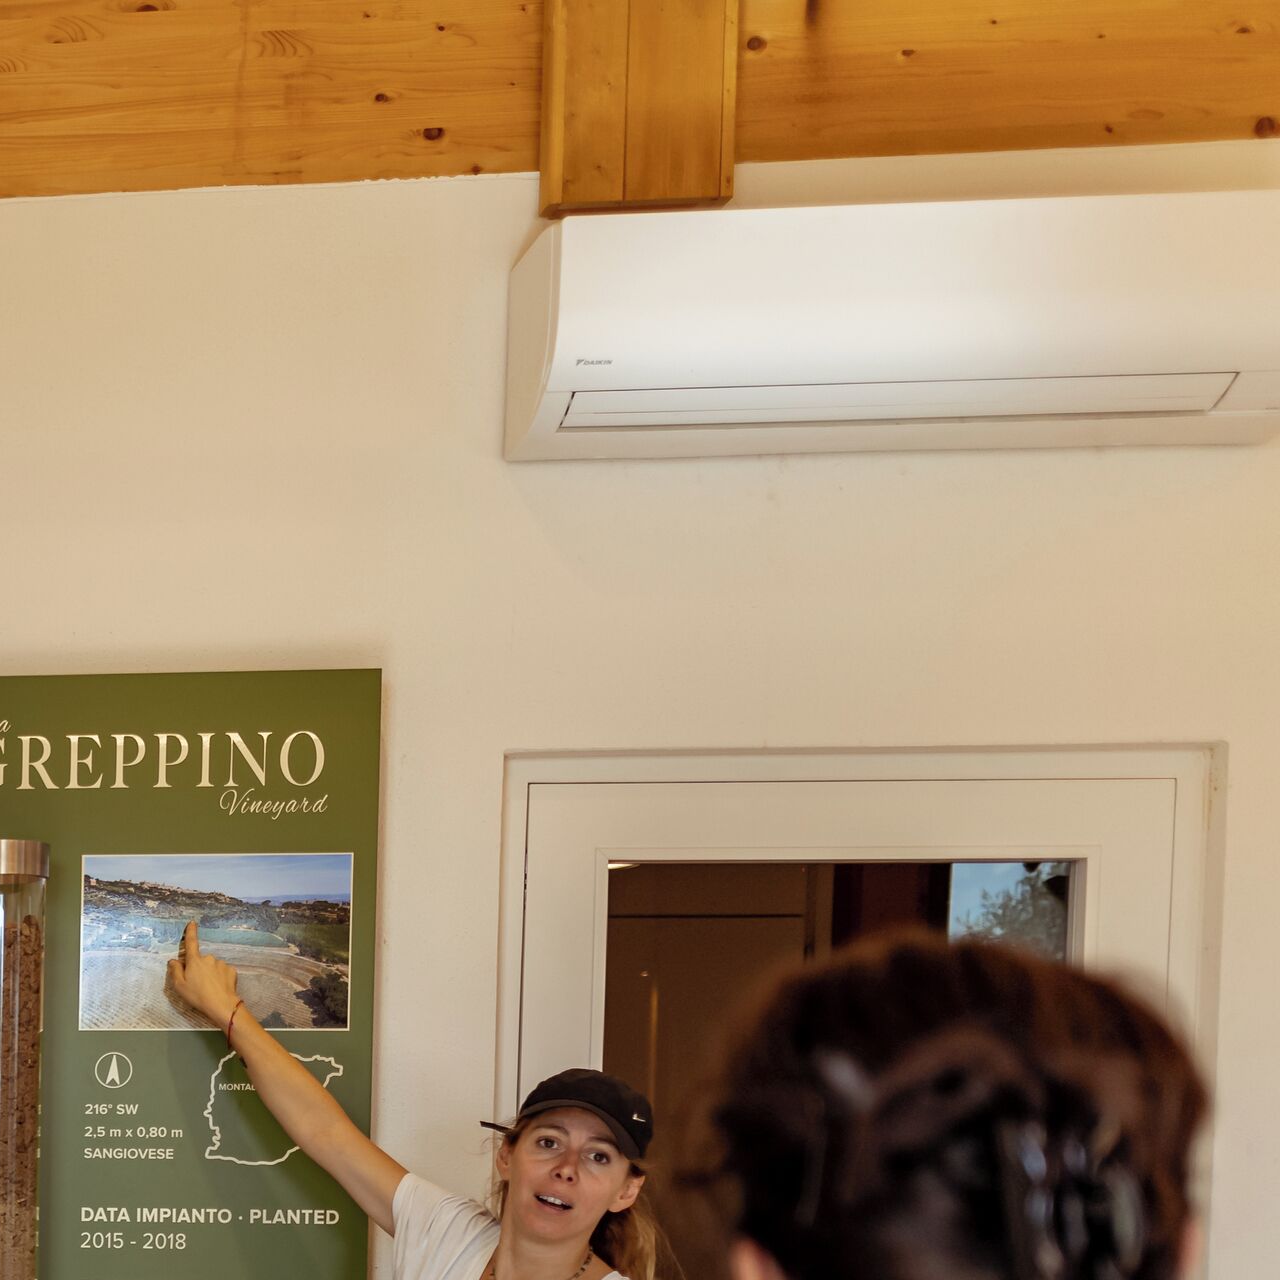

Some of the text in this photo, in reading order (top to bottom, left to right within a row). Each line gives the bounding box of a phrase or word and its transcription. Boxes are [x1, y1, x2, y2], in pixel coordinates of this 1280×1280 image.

[219, 788, 329, 820] Vineyard
[117, 1104, 138, 1114] SW
[84, 1127, 168, 1138] 2,5 0,80
[83, 1148, 174, 1159] SANGIOVESE
[80, 1207, 340, 1224] DATA IMPIANTO PLANTED
[80, 1232, 187, 1249] 2015 2018
